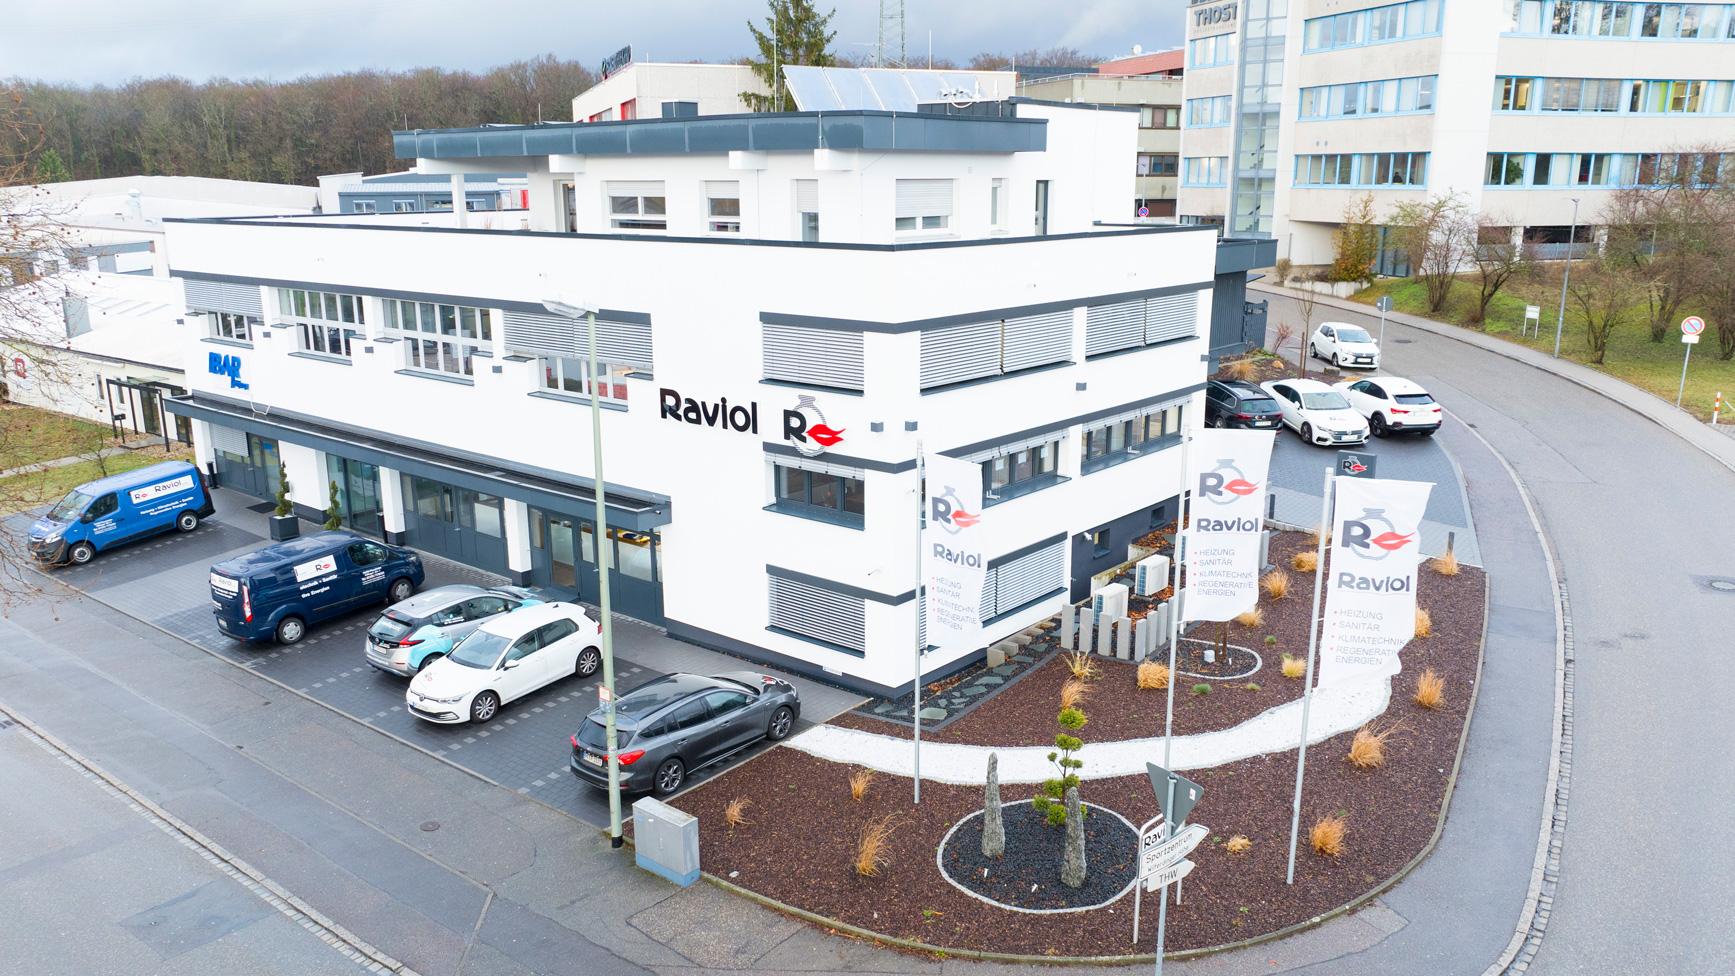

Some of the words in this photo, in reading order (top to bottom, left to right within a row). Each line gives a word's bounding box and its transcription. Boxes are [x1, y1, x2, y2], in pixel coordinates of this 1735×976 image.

[1194, 3, 1238, 27] THOST
[659, 387, 758, 435] Raviol
[154, 479, 182, 493] Raviol
[1196, 516, 1259, 533] Raviol
[933, 542, 982, 569] Raviol
[1199, 548, 1236, 557] HEIZUNG
[1337, 571, 1411, 593] Raviol
[1339, 608, 1384, 621] HEIZUNG
[1335, 655, 1383, 665] ENERGIEN
[1145, 832, 1193, 864] Sportzentrum
[1159, 867, 1179, 884] THW
